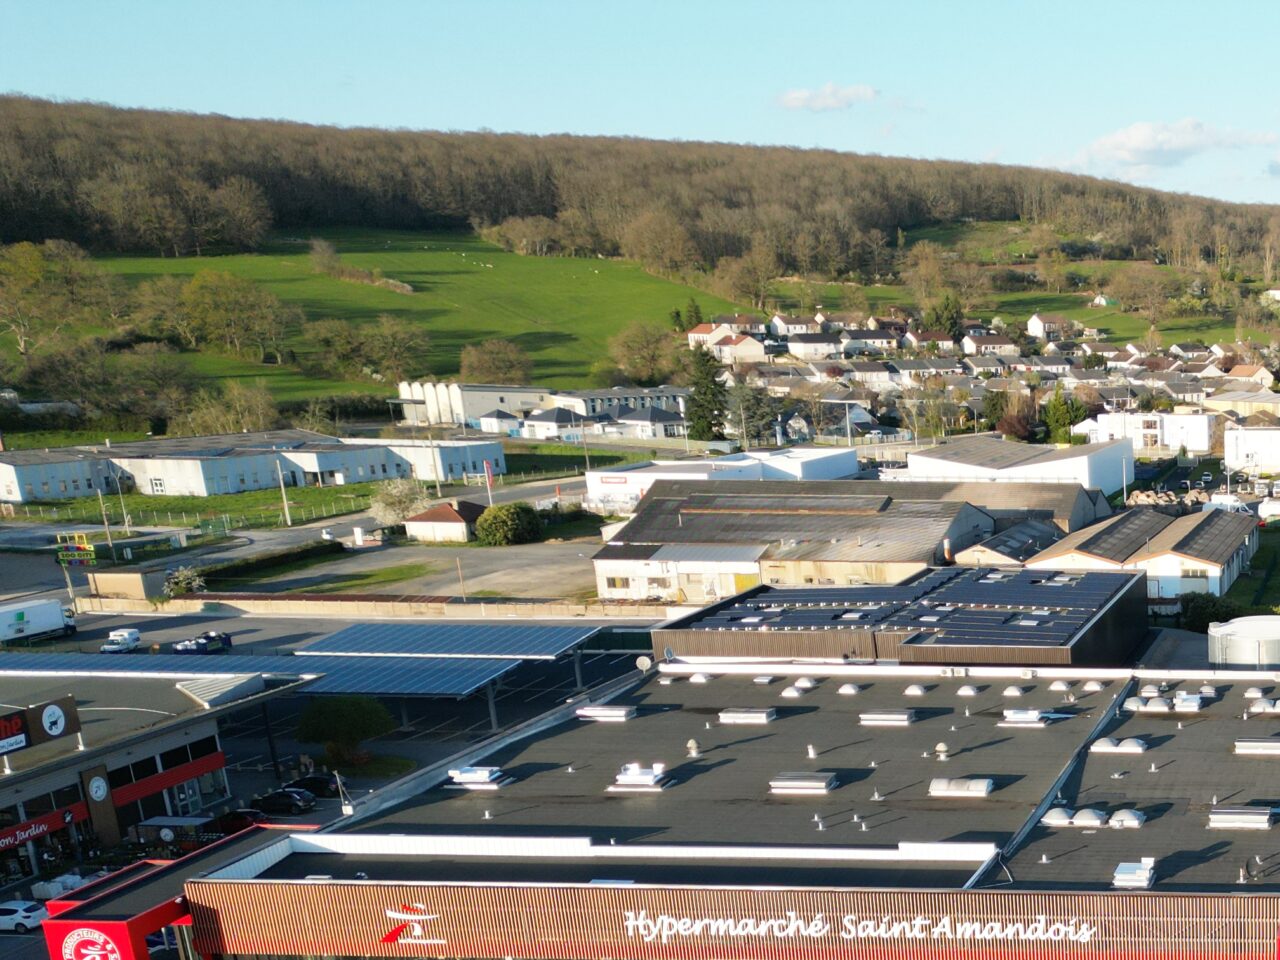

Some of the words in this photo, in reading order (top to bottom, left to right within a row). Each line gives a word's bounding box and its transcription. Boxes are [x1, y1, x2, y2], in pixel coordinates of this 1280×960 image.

[15, 824, 48, 844] Jardin
[624, 910, 830, 943] Hypermarché
[841, 915, 931, 939] Saint
[931, 914, 1097, 942] Amandois
